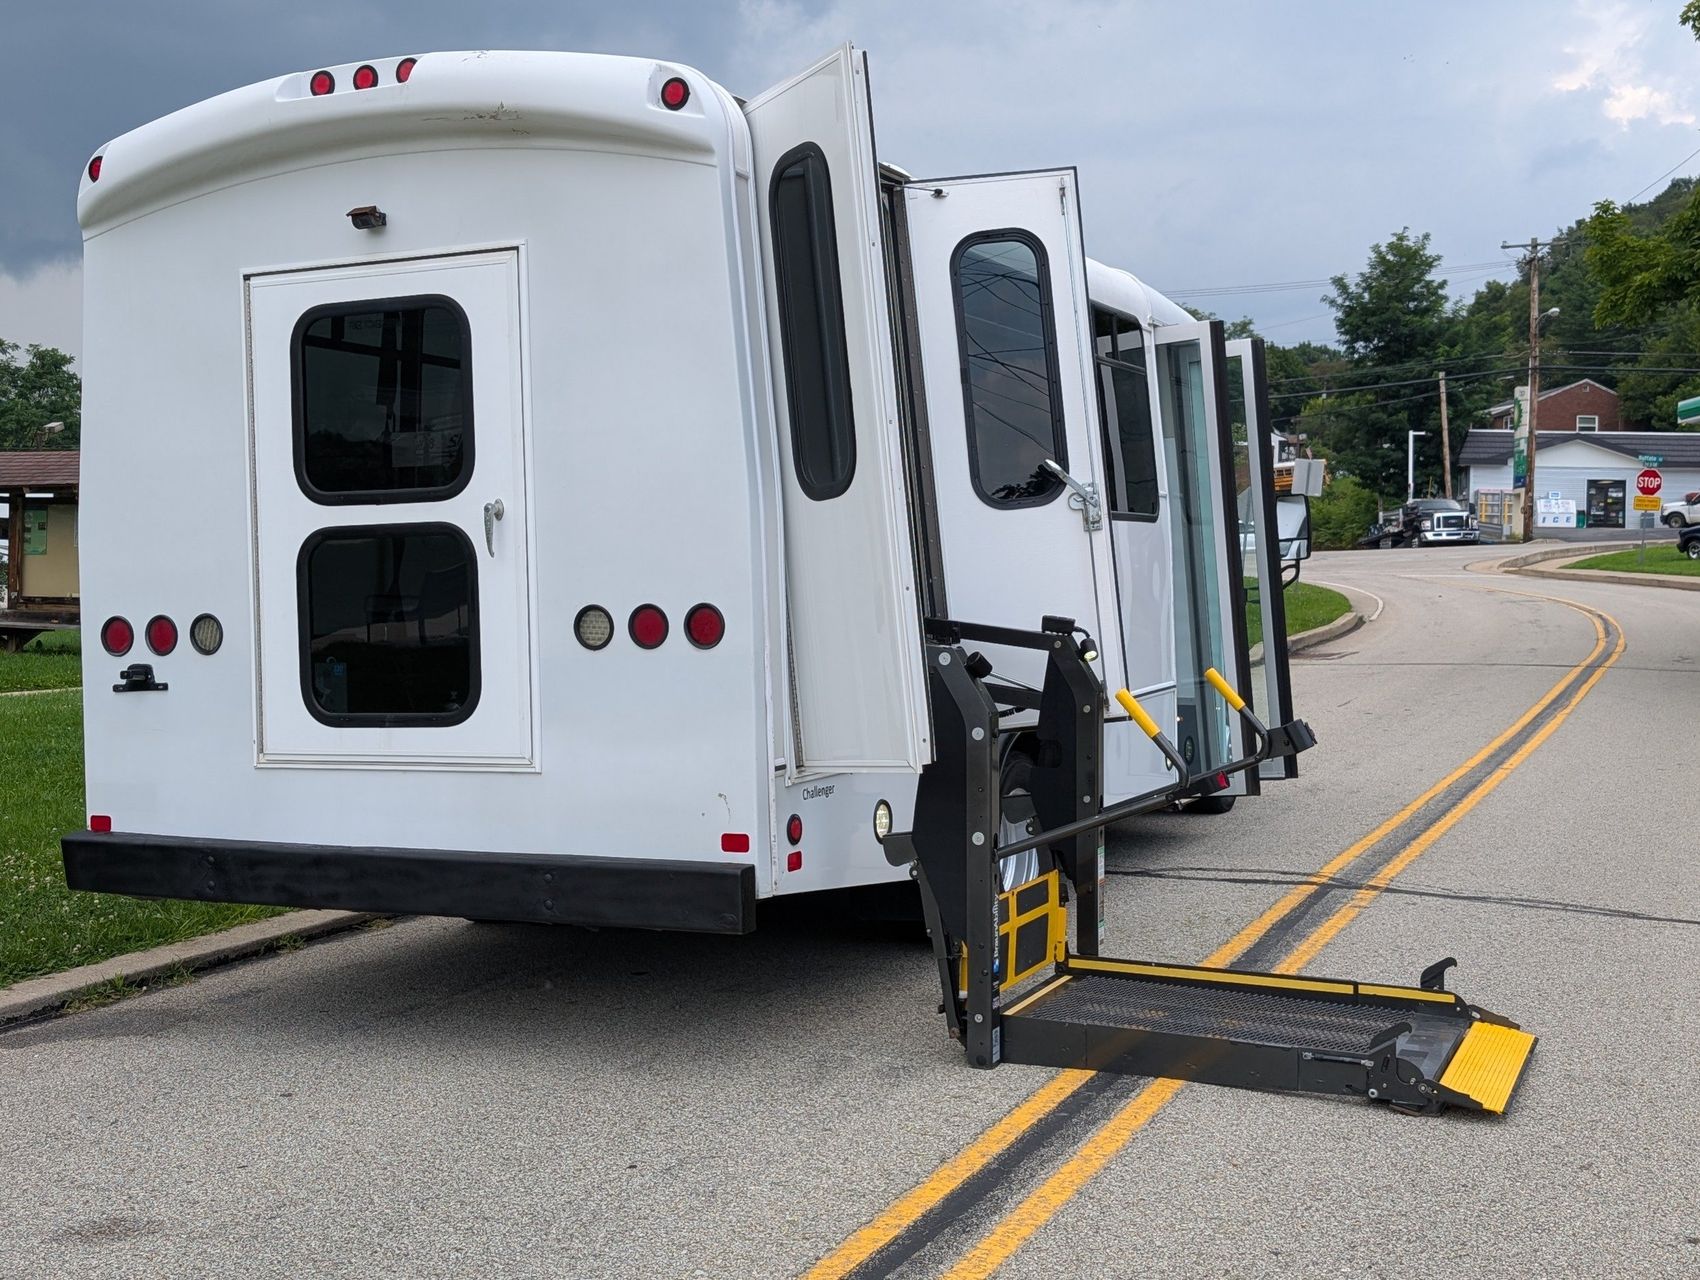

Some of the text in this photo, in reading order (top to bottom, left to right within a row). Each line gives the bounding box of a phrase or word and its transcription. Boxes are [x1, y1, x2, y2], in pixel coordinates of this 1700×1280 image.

[1637, 476, 1661, 489] STOP
[1541, 516, 1571, 524] ICE
[802, 785, 835, 800] Challenger
